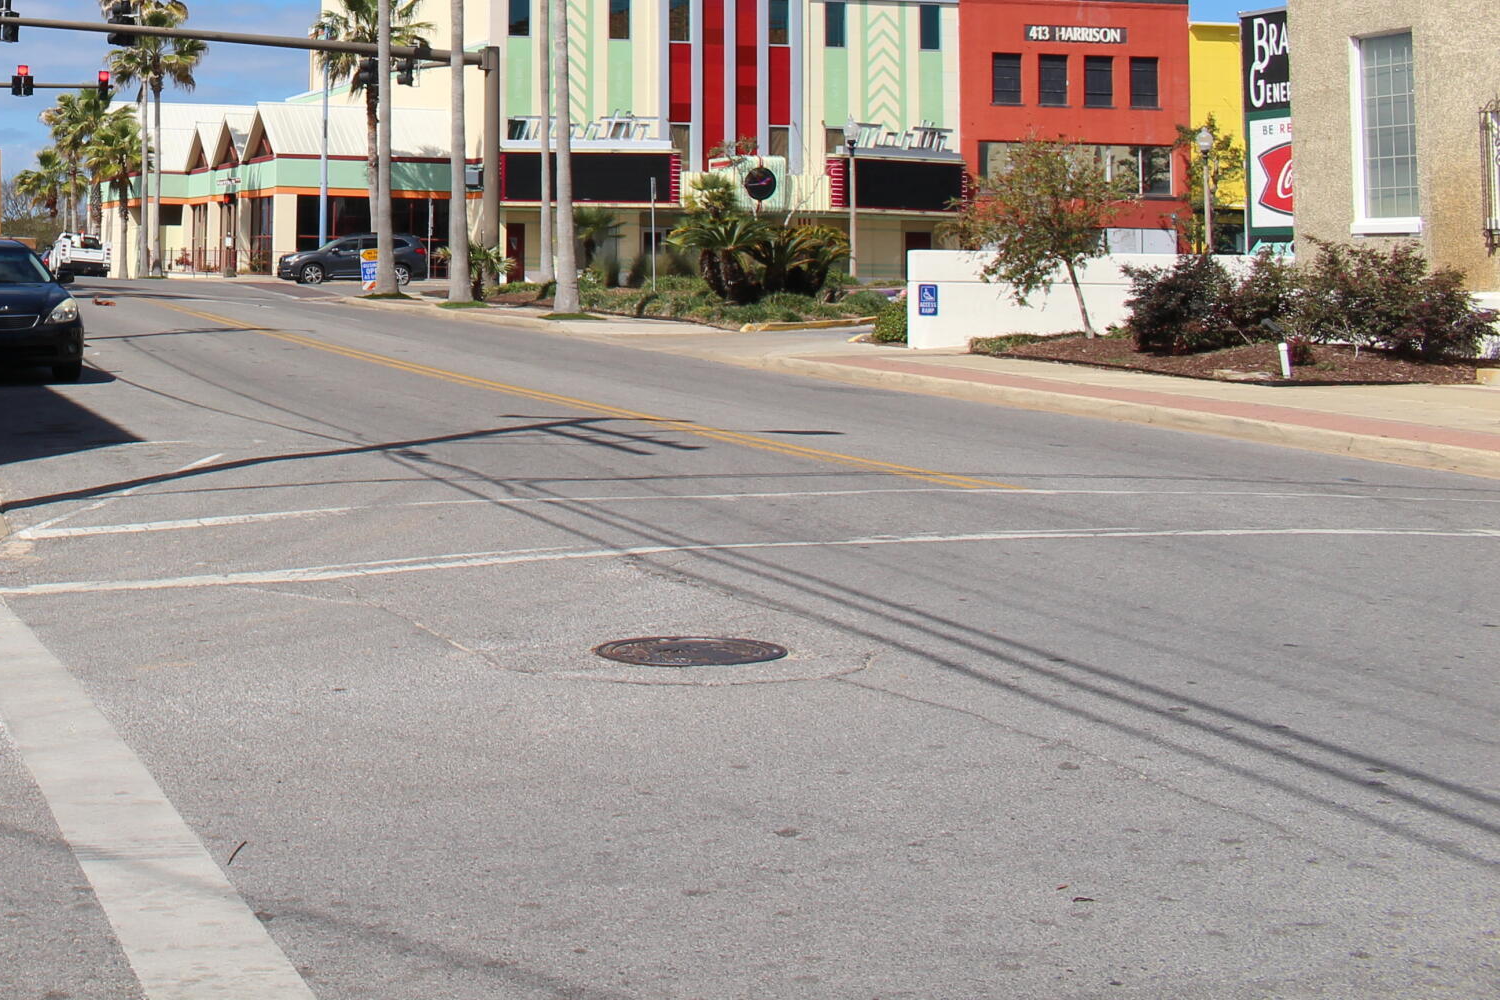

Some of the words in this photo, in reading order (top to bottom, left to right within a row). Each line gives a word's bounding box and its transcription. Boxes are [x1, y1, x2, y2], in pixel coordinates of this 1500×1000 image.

[1029, 26, 1050, 40] 413
[1055, 27, 1121, 43] HARRISON
[1262, 125, 1274, 136] BE
